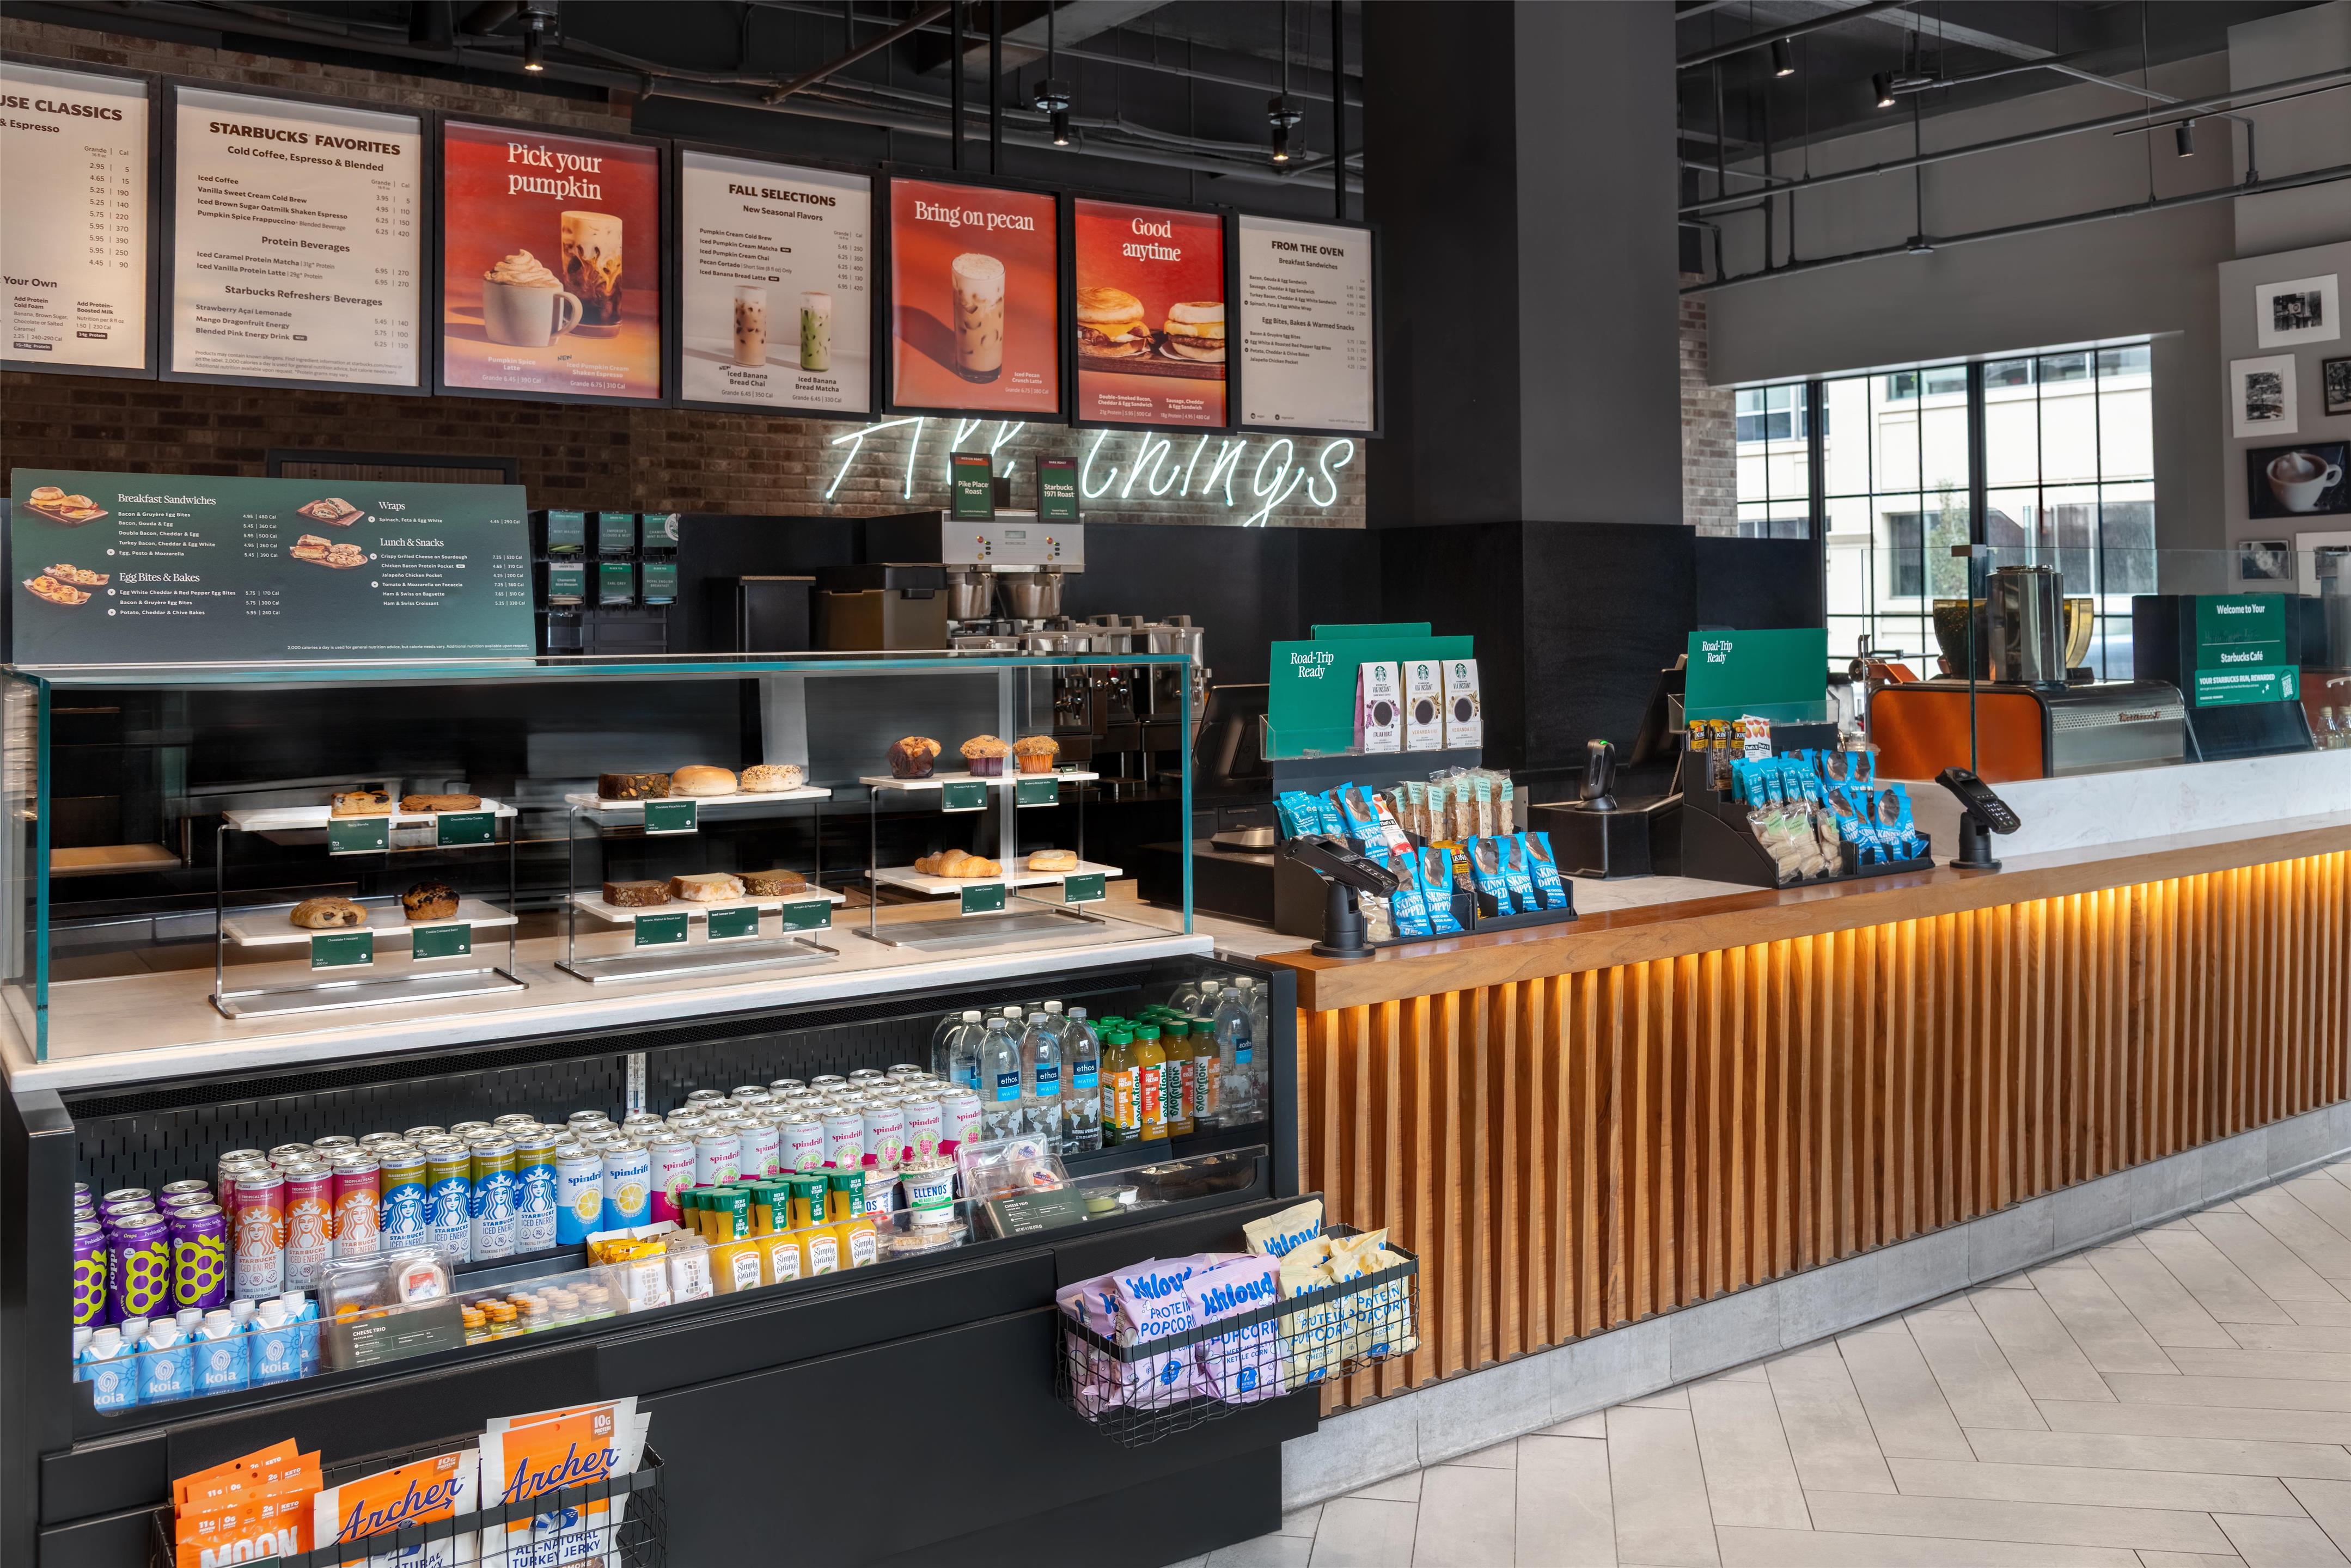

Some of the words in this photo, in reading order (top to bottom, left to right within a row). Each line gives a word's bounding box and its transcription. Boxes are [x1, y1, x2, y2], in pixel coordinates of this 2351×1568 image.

[35, 100, 122, 121] CLASSICS
[0, 118, 7, 126] &
[10, 120, 59, 133] Espresso
[315, 134, 400, 155] FAVORITES
[228, 146, 250, 156] Cold
[253, 149, 288, 161] Coffee,
[290, 154, 333, 167] Espresso
[345, 161, 384, 171] Blended
[508, 143, 553, 168] Pick
[555, 153, 602, 173] your
[509, 174, 602, 200] pumpkin
[729, 184, 758, 197] FALL
[761, 188, 836, 206] SELECTIONS
[762, 207, 795, 218] Seasonal
[797, 212, 823, 221] Flavors
[915, 201, 961, 228] Bring
[963, 210, 985, 225] on
[986, 212, 1035, 231] pecan
[1132, 218, 1172, 238] Good
[1122, 243, 1181, 261] anytime
[1272, 241, 1298, 252] FROM
[1300, 244, 1317, 254] THE
[1320, 247, 1344, 257] OVEN
[1279, 258, 1305, 266] Breakfast
[1306, 261, 1338, 270] Sandwiches
[3, 276, 29, 285] Your
[32, 279, 57, 288] Own
[225, 285, 275, 297] Starbucks
[334, 295, 382, 307] Beverages
[196, 304, 236, 314] Strawberry
[238, 307, 254, 315] Açaí
[255, 309, 292, 317] Lemonade
[118, 494, 162, 503] Breakfast
[164, 495, 216, 505] Sandwiches
[378, 501, 405, 511] Wraps
[381, 538, 405, 547] Lunch
[416, 539, 444, 547] Snacks
[120, 573, 137, 583] Egg
[138, 573, 162, 581] Bites
[173, 574, 200, 582] Bakes
[2216, 605, 2244, 614] Welcome
[2245, 605, 2251, 613] to
[2252, 604, 2265, 613] Your
[1702, 641, 1732, 653] Road-Trip
[1291, 652, 1334, 665] Road-Trip
[1707, 652, 1726, 665] Ready
[2221, 652, 2249, 663] Starbucks
[2250, 651, 2263, 661] Café
[1298, 665, 1325, 679] Ready
[909, 1117, 939, 1128] spindrift
[832, 1130, 863, 1142] spindrift
[792, 1137, 822, 1150] spindrift
[663, 1156, 695, 1171] spindrift
[610, 1164, 648, 1179] spindrift
[914, 1184, 946, 1198] ELLENOS
[521, 1218, 534, 1227] ICED
[535, 1217, 553, 1226] ENERGY
[854, 1238, 874, 1250] Simply
[854, 1247, 875, 1259] Orange
[1126, 1267, 1192, 1300] khloud
[1201, 1272, 1275, 1316] khloud
[261, 1361, 290, 1375] koia
[206, 1371, 236, 1384] koia
[150, 1380, 180, 1393] koia
[594, 1415, 610, 1428] 10G
[594, 1425, 611, 1434] PROTEIN
[499, 1442, 620, 1506] Archer
[333, 1477, 465, 1546] Archer
[513, 1552, 561, 1568] TURKEY
[565, 1539, 600, 1558] JERKY
